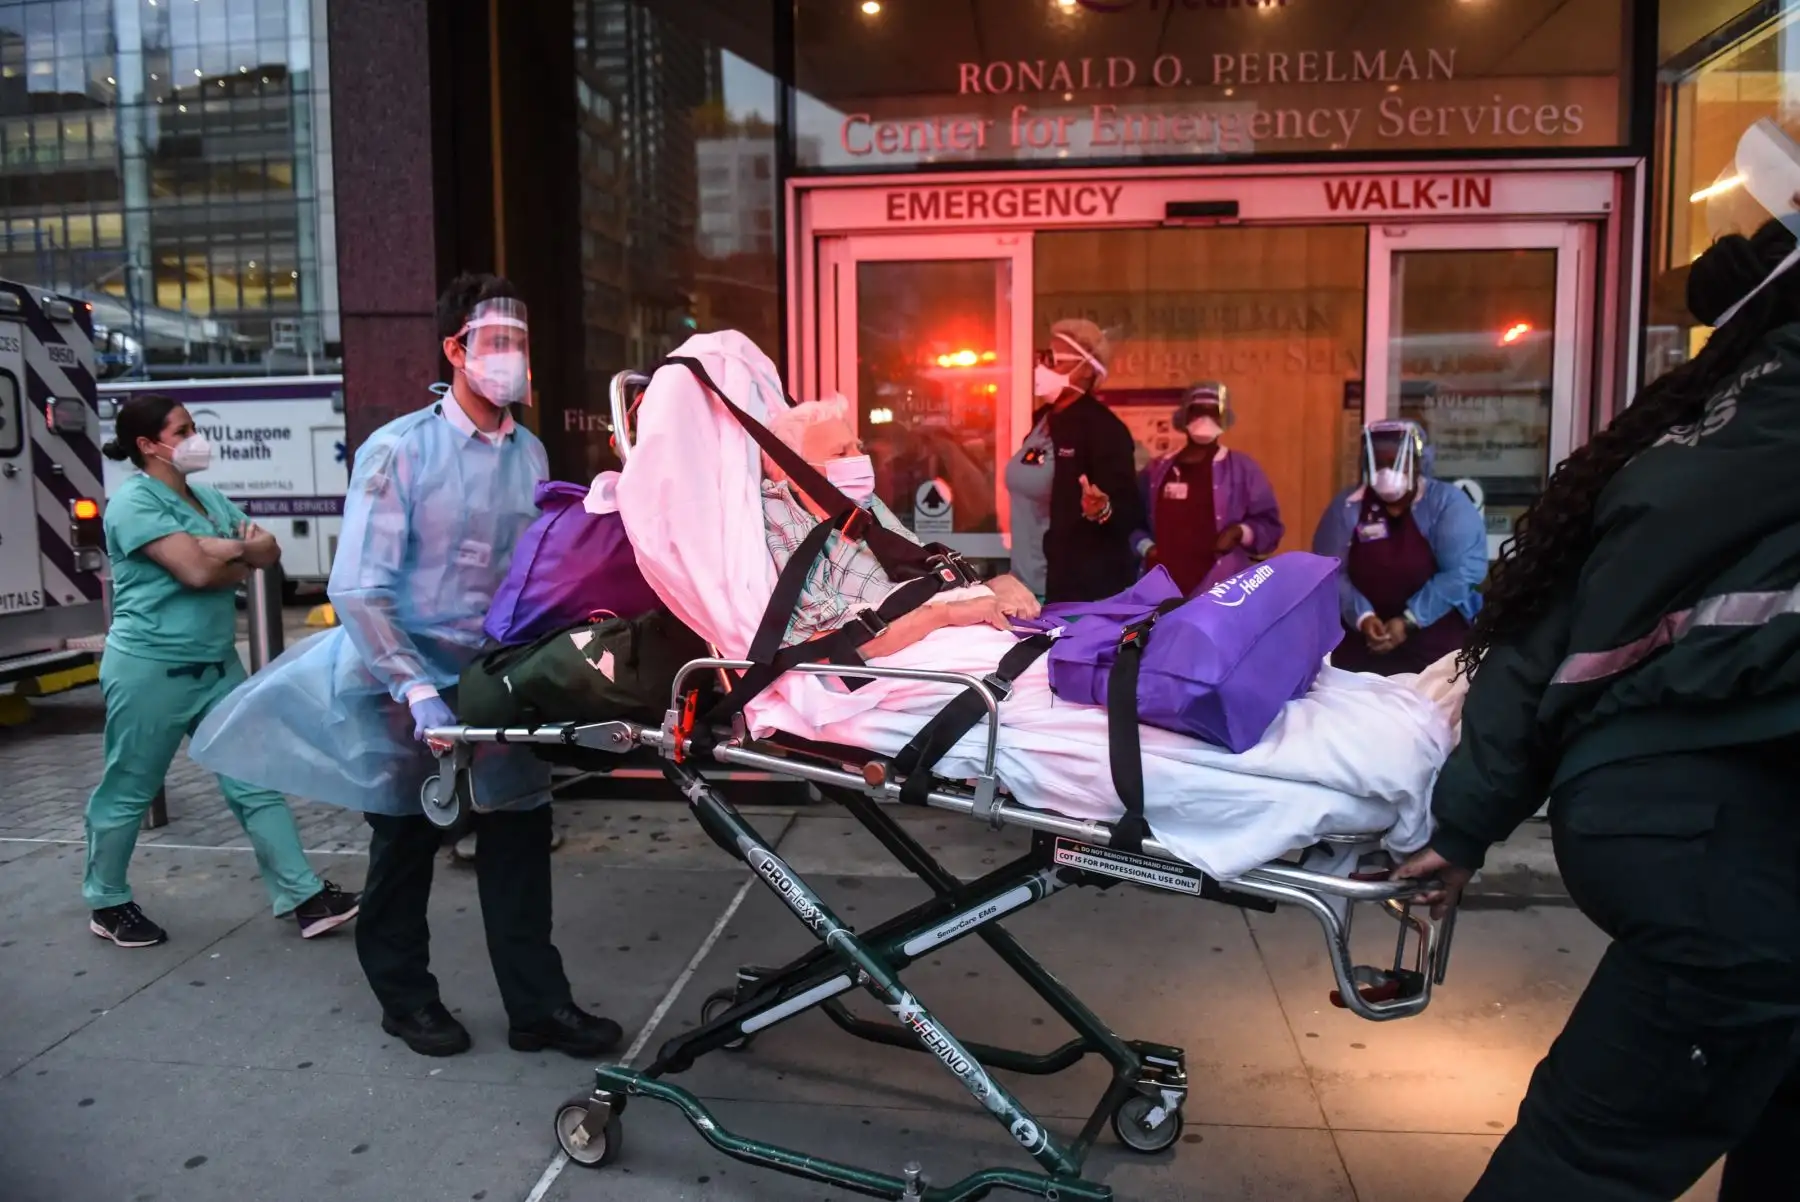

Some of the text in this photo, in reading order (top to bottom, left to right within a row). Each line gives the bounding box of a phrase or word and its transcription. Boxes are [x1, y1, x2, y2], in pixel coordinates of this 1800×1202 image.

[958, 48, 1457, 94] RONALD O. PERELMAN
[840, 95, 1585, 156] Center for Emergency Services
[886, 186, 1124, 221] EMERGENCY
[1323, 177, 1492, 211] WALK-IN
[226, 425, 292, 444] Langone
[564, 408, 612, 432] Firs
[220, 444, 271, 461] Health
[250, 502, 290, 513] MEDICAL
[293, 501, 338, 512] SERVICES
[1239, 564, 1275, 595] Health
[1059, 852, 1197, 889] COT IS FOR PROFESSIONAL USE ONLY
[1091, 848, 1104, 856] NOT
[1104, 851, 1129, 862] REMOVE
[1129, 857, 1143, 865] THIS
[1143, 860, 1162, 869] HAND
[1162, 864, 1184, 874] GUARD
[937, 905, 997, 939] SeniorCare EMS
[913, 1018, 973, 1076] FERNO
